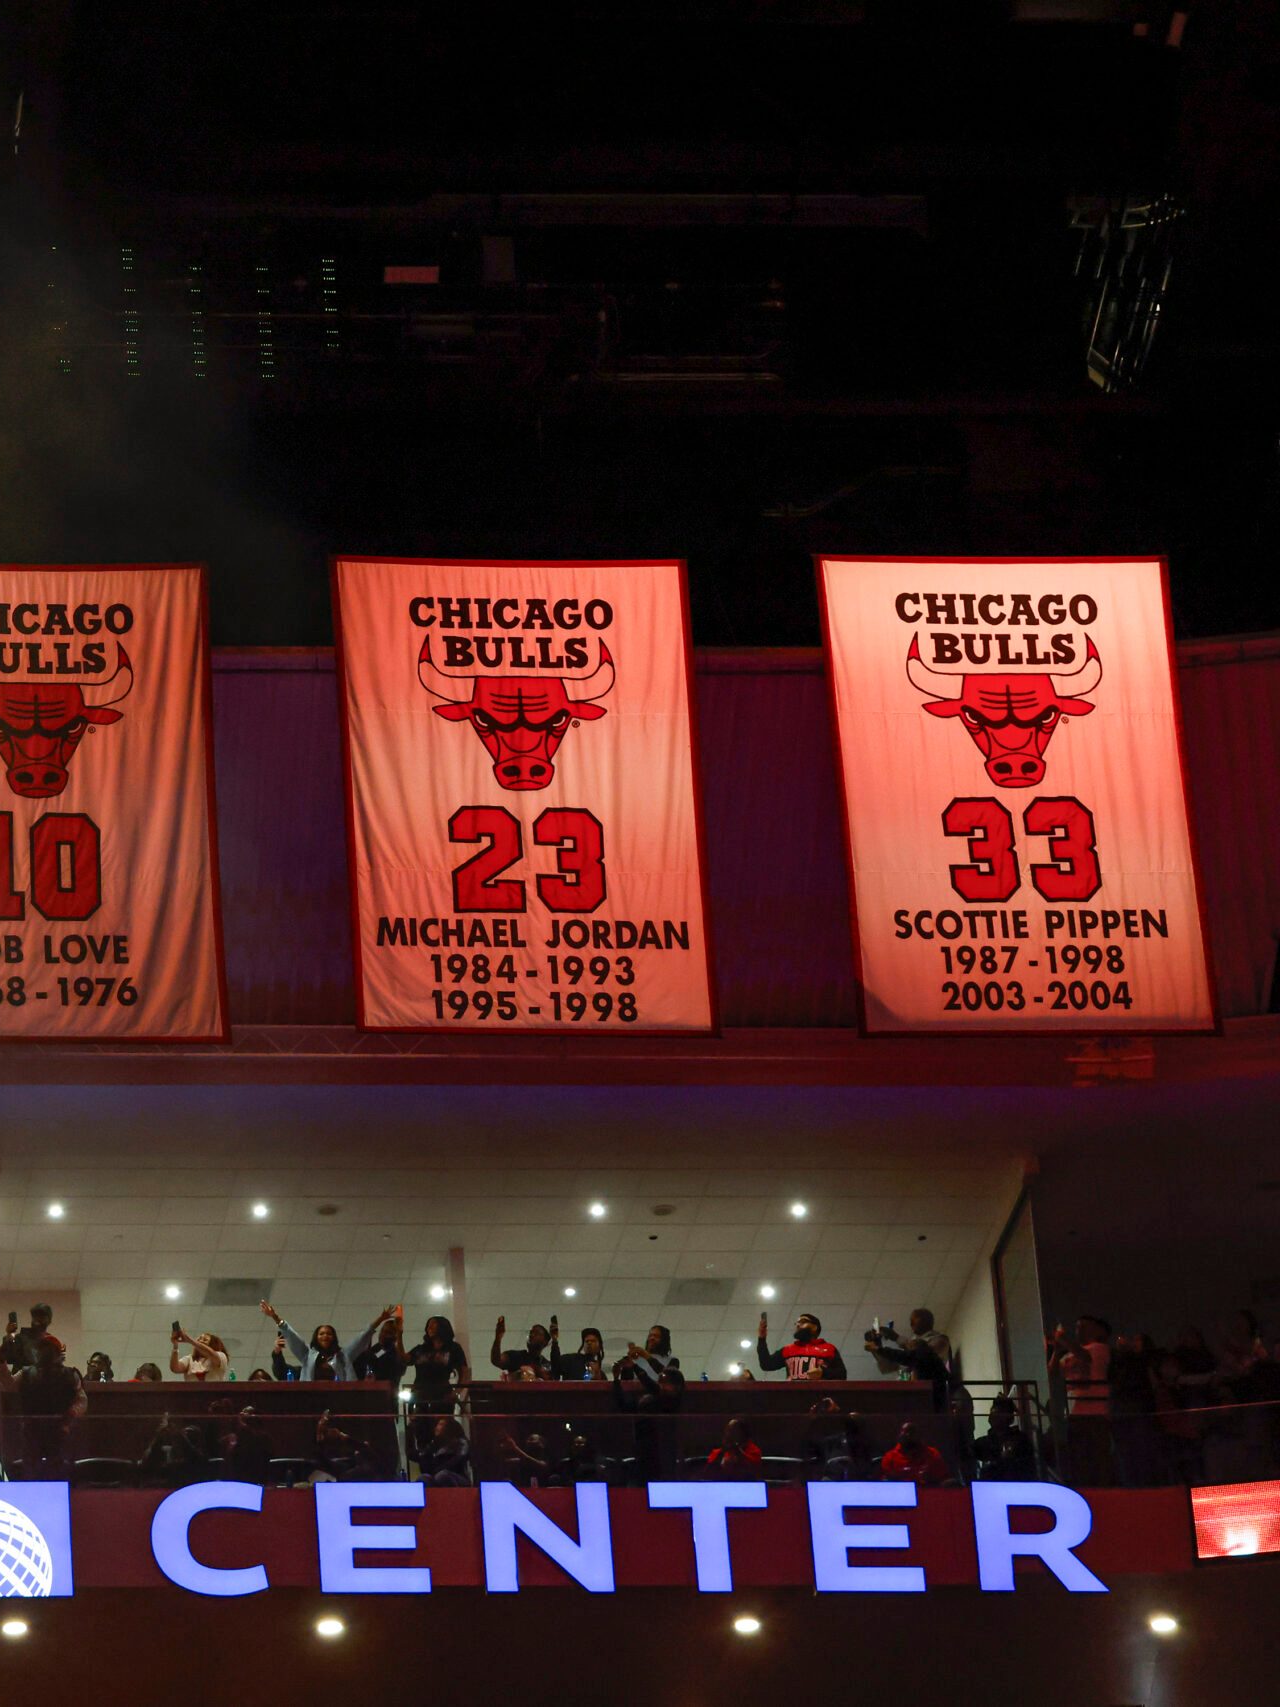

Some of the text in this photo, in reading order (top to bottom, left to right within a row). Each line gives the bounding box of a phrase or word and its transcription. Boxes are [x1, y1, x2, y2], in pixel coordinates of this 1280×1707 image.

[409, 597, 613, 630] CHICAGO
[895, 593, 1097, 625] CHICAGO
[442, 636, 588, 668] BULLS
[931, 633, 1075, 664] BULLS
[448, 805, 607, 914] 23
[942, 796, 1102, 903] 33
[377, 917, 689, 949] MICHAEL JORDAN
[894, 910, 1168, 939] SCOTTIE PIPPEN
[44, 935, 129, 964] LOVE
[151, 1481, 1109, 1596] CENTER
